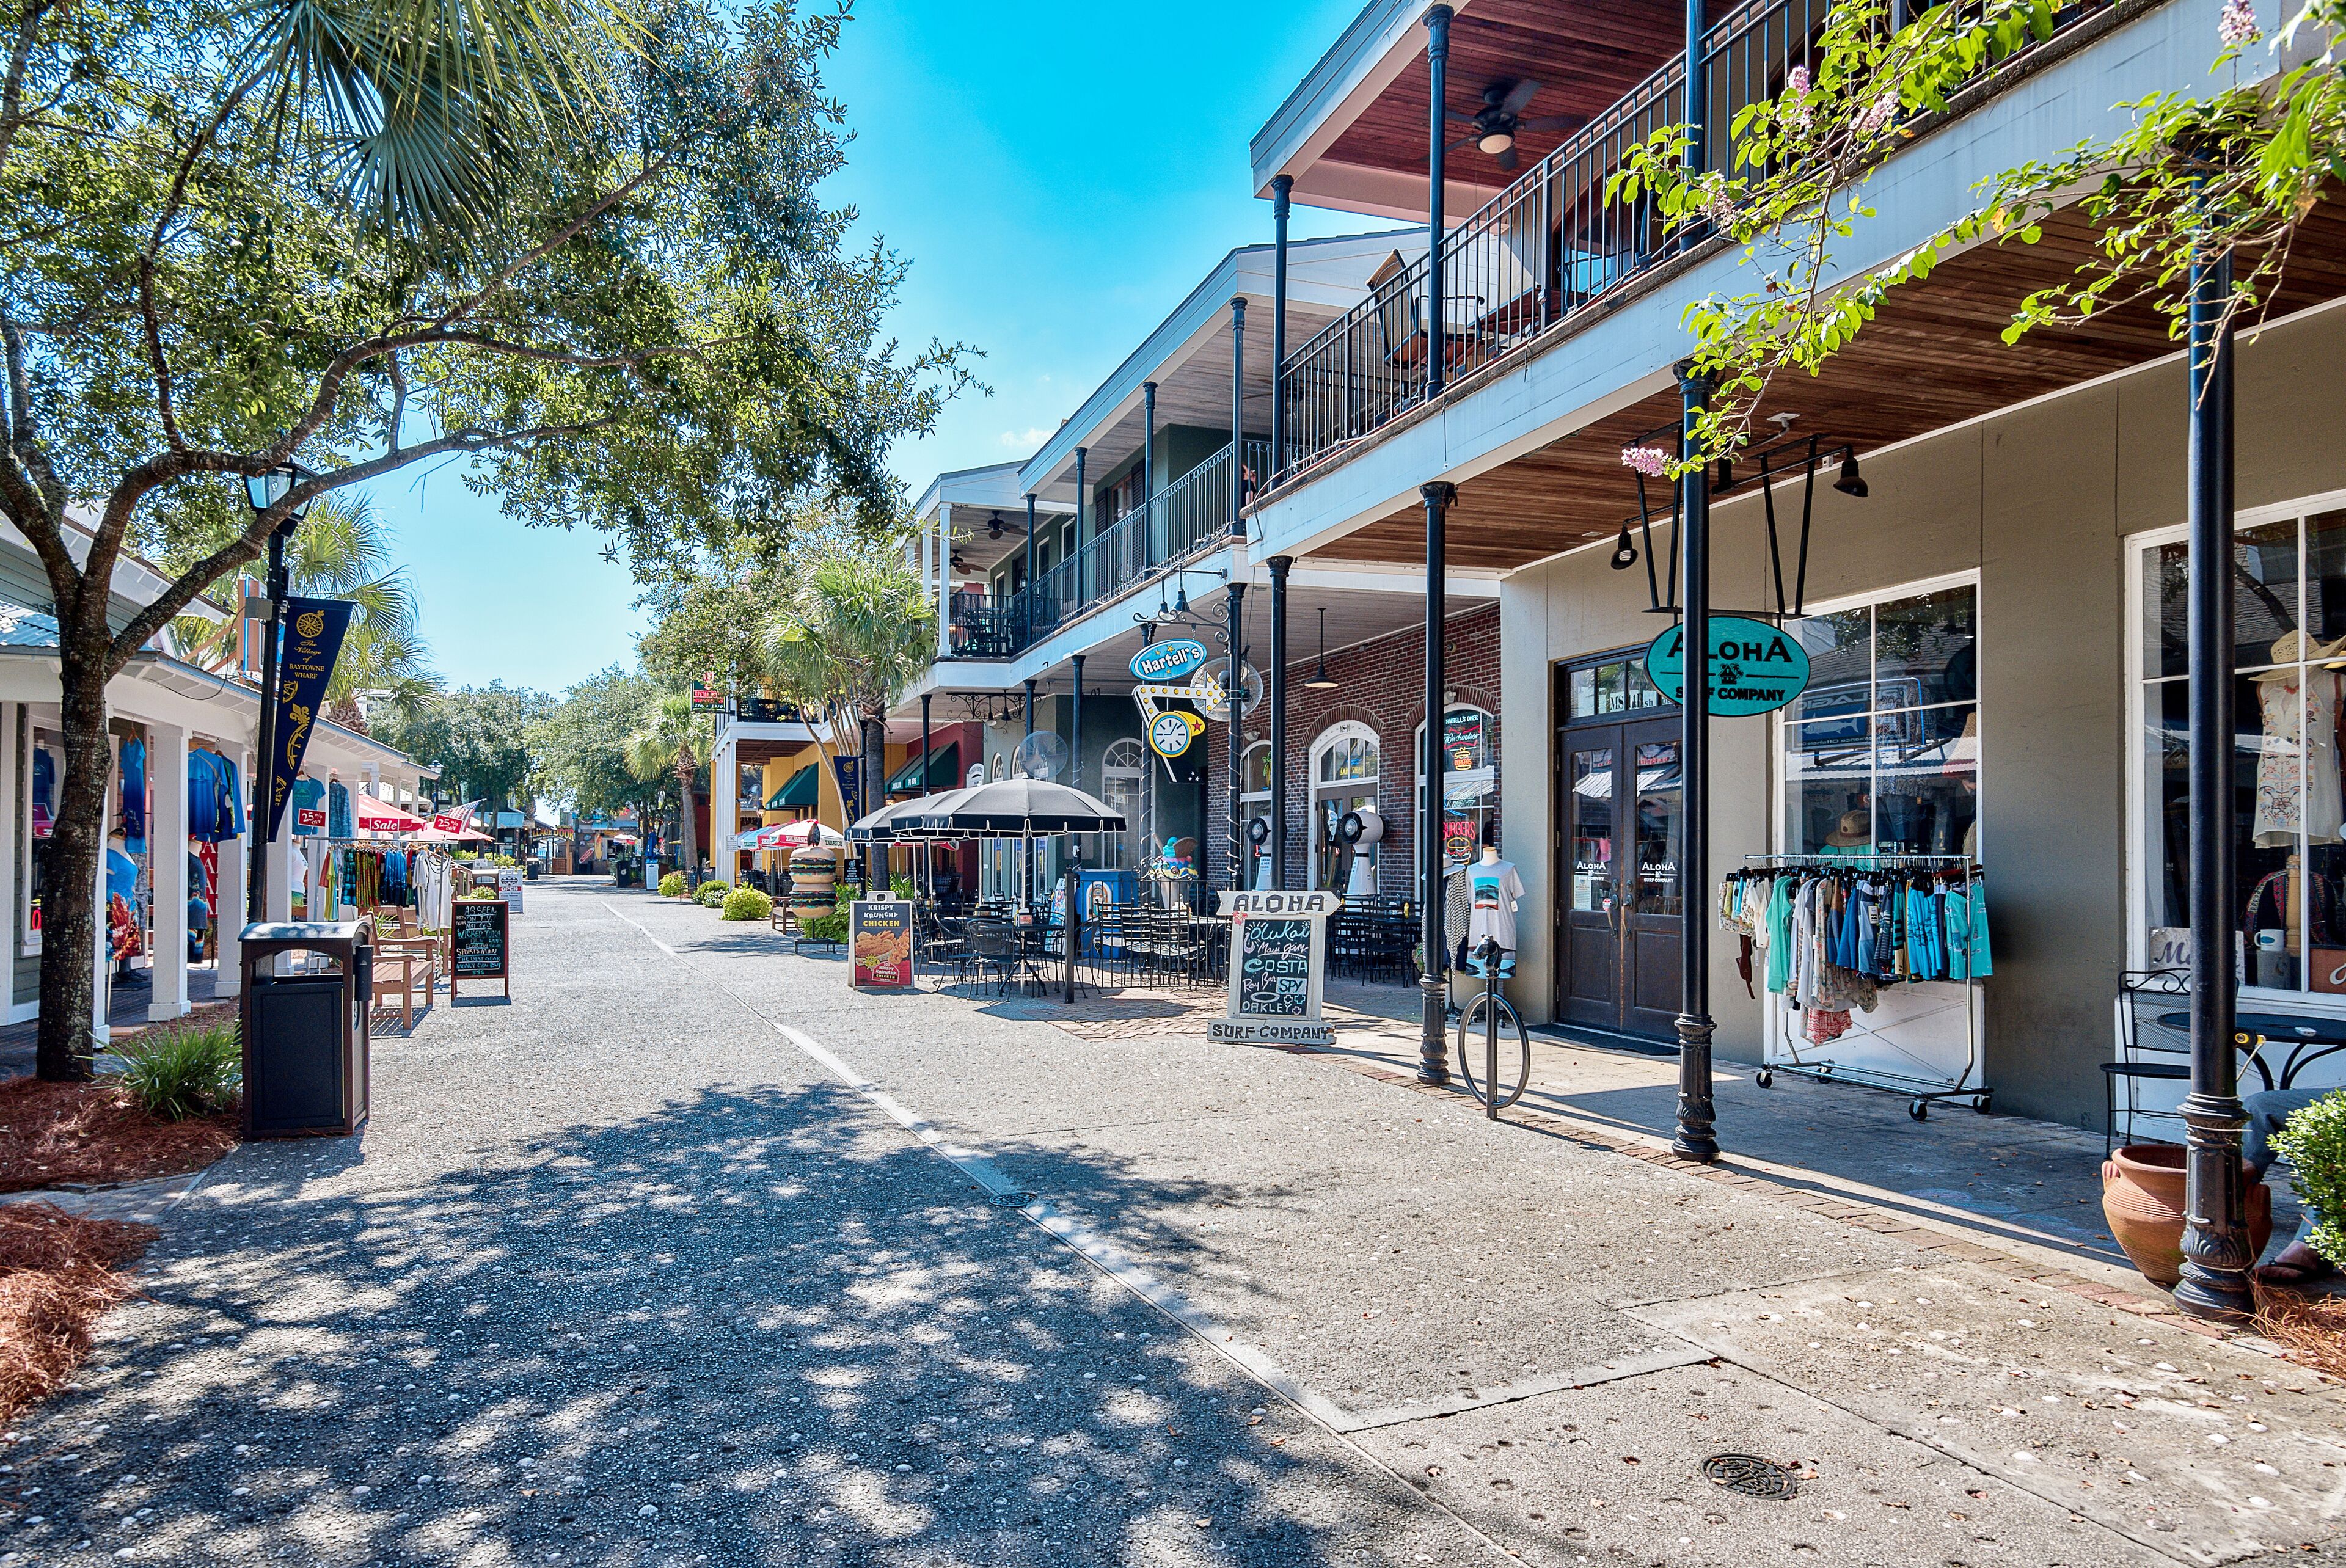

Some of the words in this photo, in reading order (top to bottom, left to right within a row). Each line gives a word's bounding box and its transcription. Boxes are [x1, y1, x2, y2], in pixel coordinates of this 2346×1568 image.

[294, 647, 321, 656] Village
[1141, 646, 1200, 674] Hartell's
[1718, 688, 1785, 701] COMPANY
[1444, 732, 1480, 744] Budweiser
[1447, 800, 1476, 808] LIGHT
[371, 820, 397, 830] Sale
[554, 828, 574, 841] DOOR
[1577, 861, 1606, 870] ALOHA
[1642, 862, 1676, 871] ALOHA
[1233, 894, 1325, 913] ALOHA
[477, 906, 497, 914] SEEN
[1244, 958, 1308, 974] COSTA
[1279, 980, 1303, 993] SPY
[1242, 1001, 1292, 1013] OAKLEY
[1212, 1024, 1255, 1038] SURF
[1260, 1025, 1329, 1040] COMPANY
